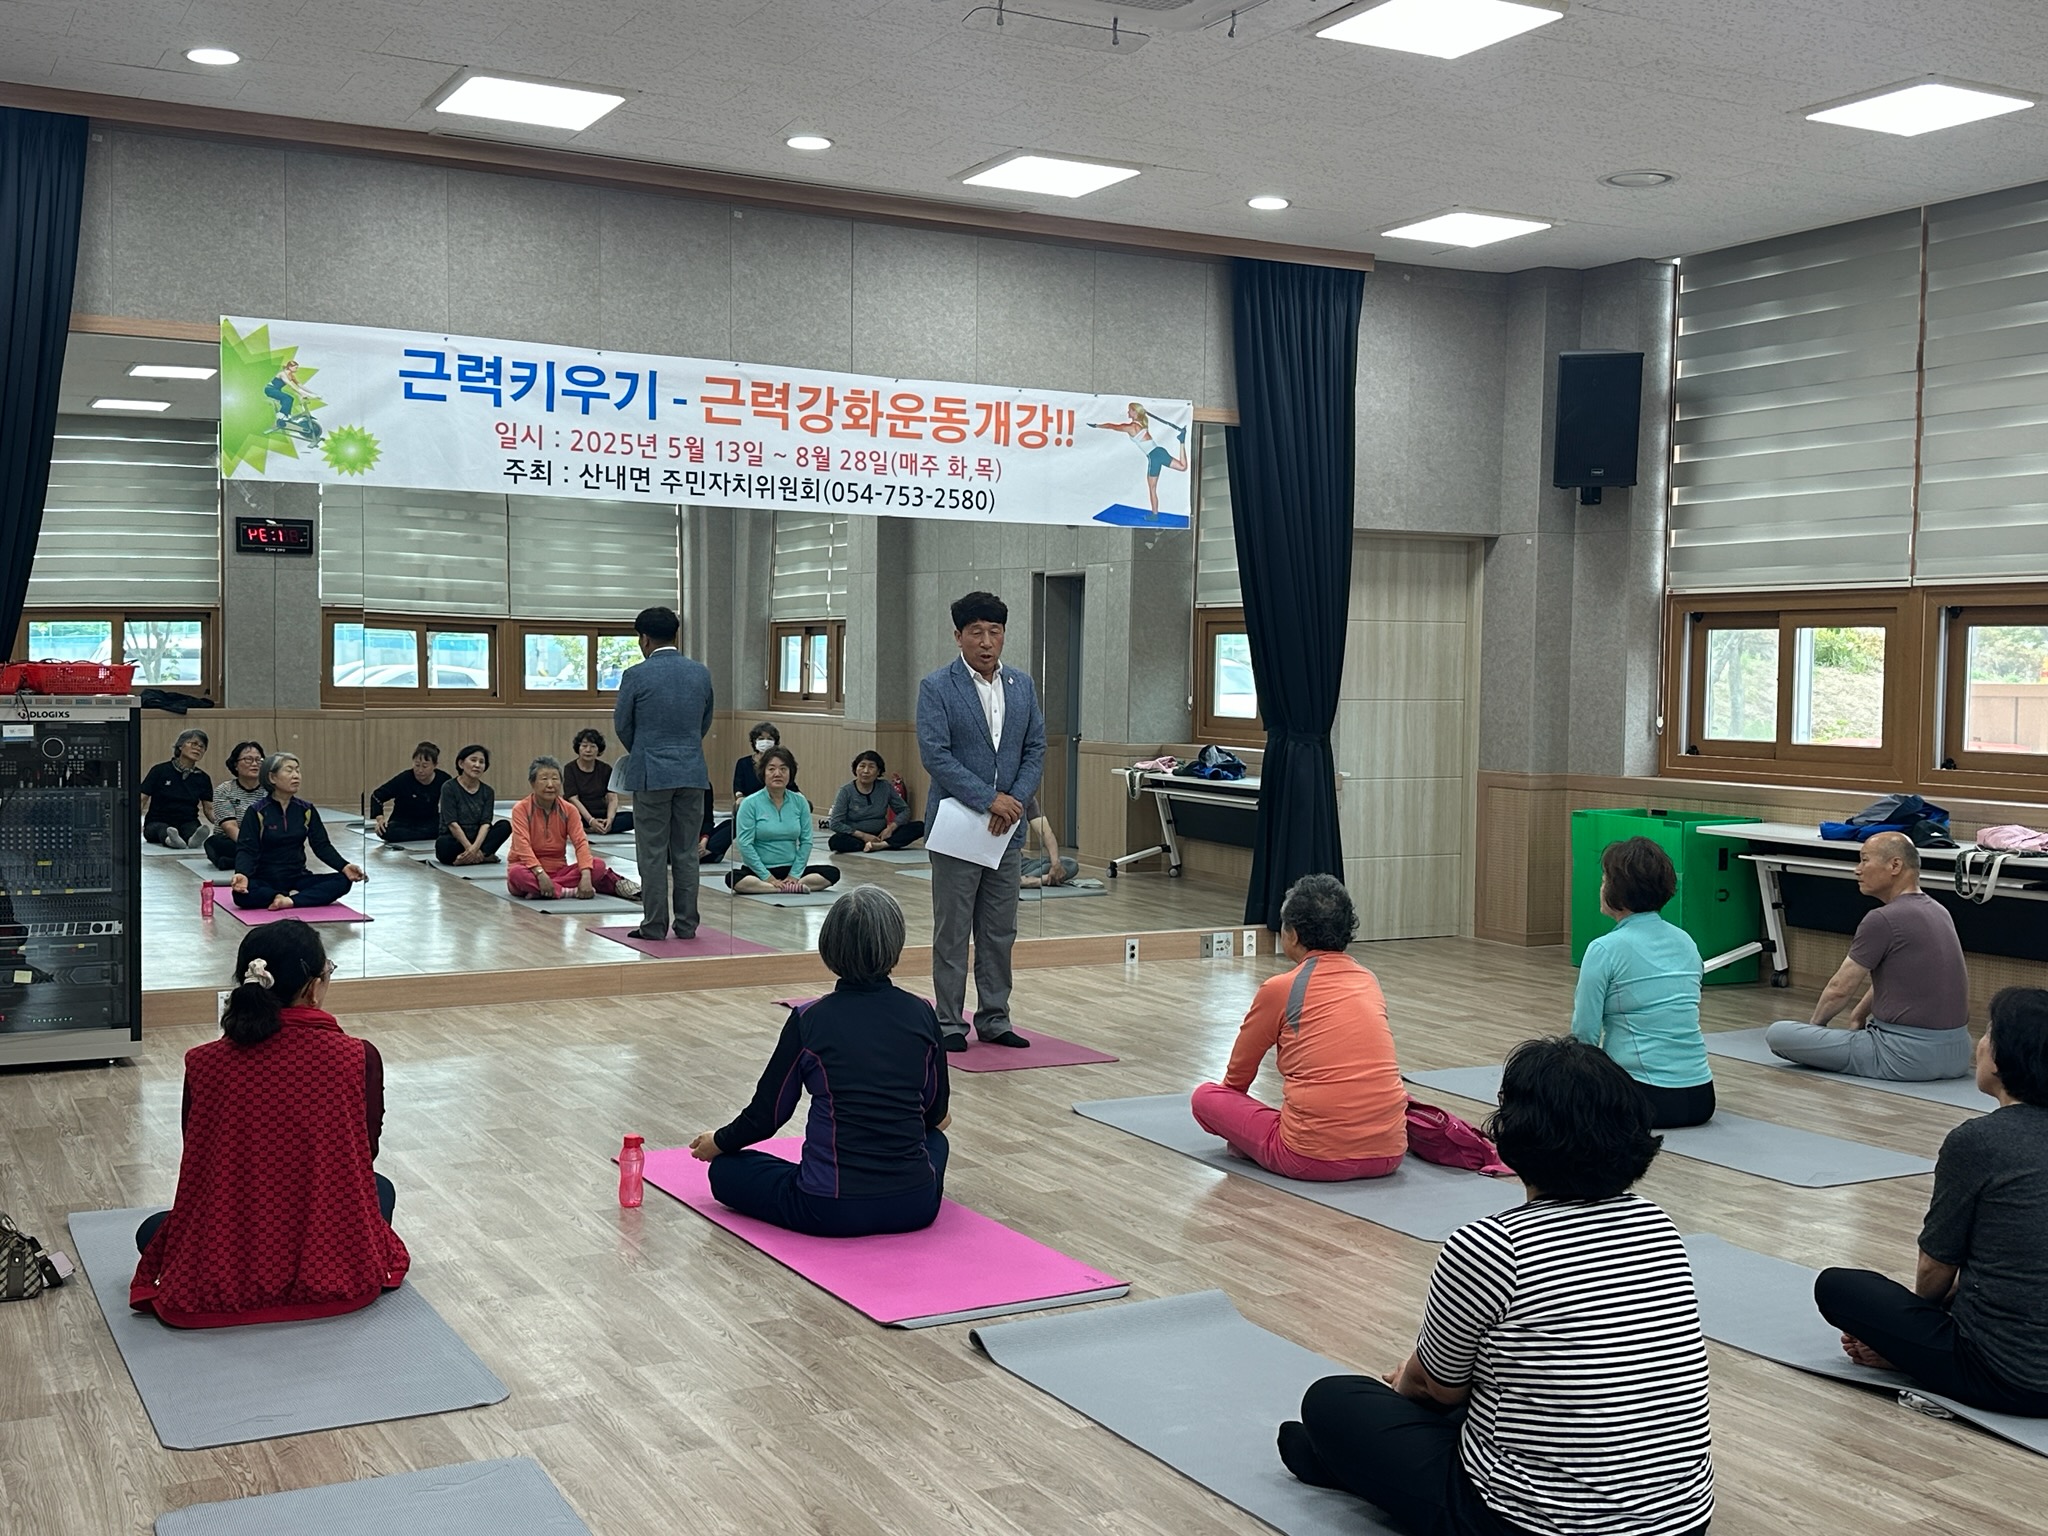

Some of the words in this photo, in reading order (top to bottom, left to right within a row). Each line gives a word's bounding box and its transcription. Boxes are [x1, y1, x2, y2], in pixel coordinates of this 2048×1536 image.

[399, 348, 657, 421] 근력키우기
[699, 376, 1075, 449] 근력강화운동개강!!
[495, 422, 543, 451] 일시
[570, 429, 658, 460] 2025년
[668, 436, 705, 463] 5월
[714, 440, 763, 468] 13일
[773, 451, 788, 459] ~
[796, 446, 831, 472] 8월
[840, 449, 940, 478] 28일(매주
[948, 455, 1003, 483] 화,목)
[503, 458, 552, 486] 주최
[578, 463, 651, 493] 산내면
[660, 469, 996, 514] 주민자치위원회(054-753-2580)
